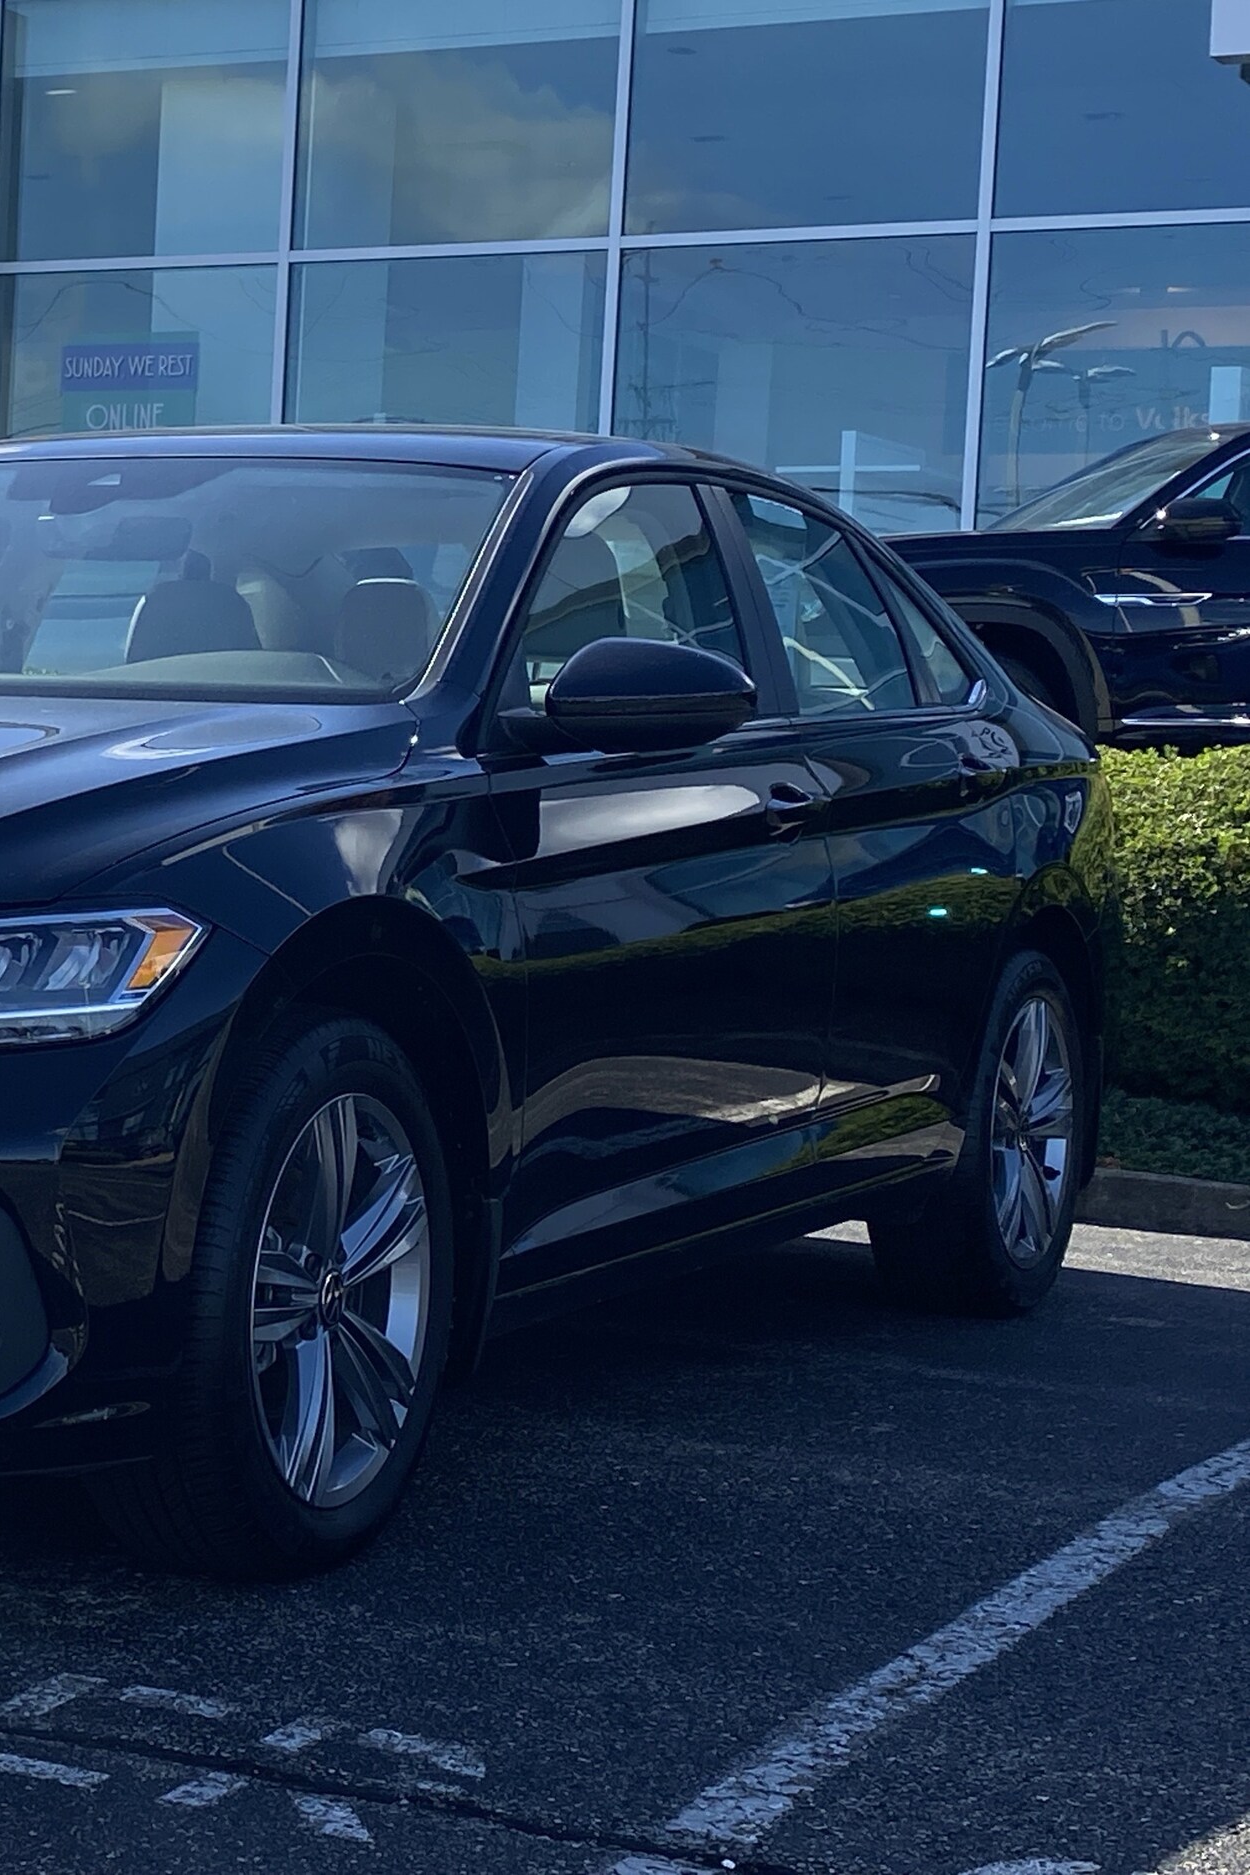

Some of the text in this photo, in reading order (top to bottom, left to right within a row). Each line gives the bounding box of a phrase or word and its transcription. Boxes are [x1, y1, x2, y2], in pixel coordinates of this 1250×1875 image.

[128, 355, 155, 376] WE
[158, 354, 193, 376] REST
[86, 403, 164, 430] ONLINE
